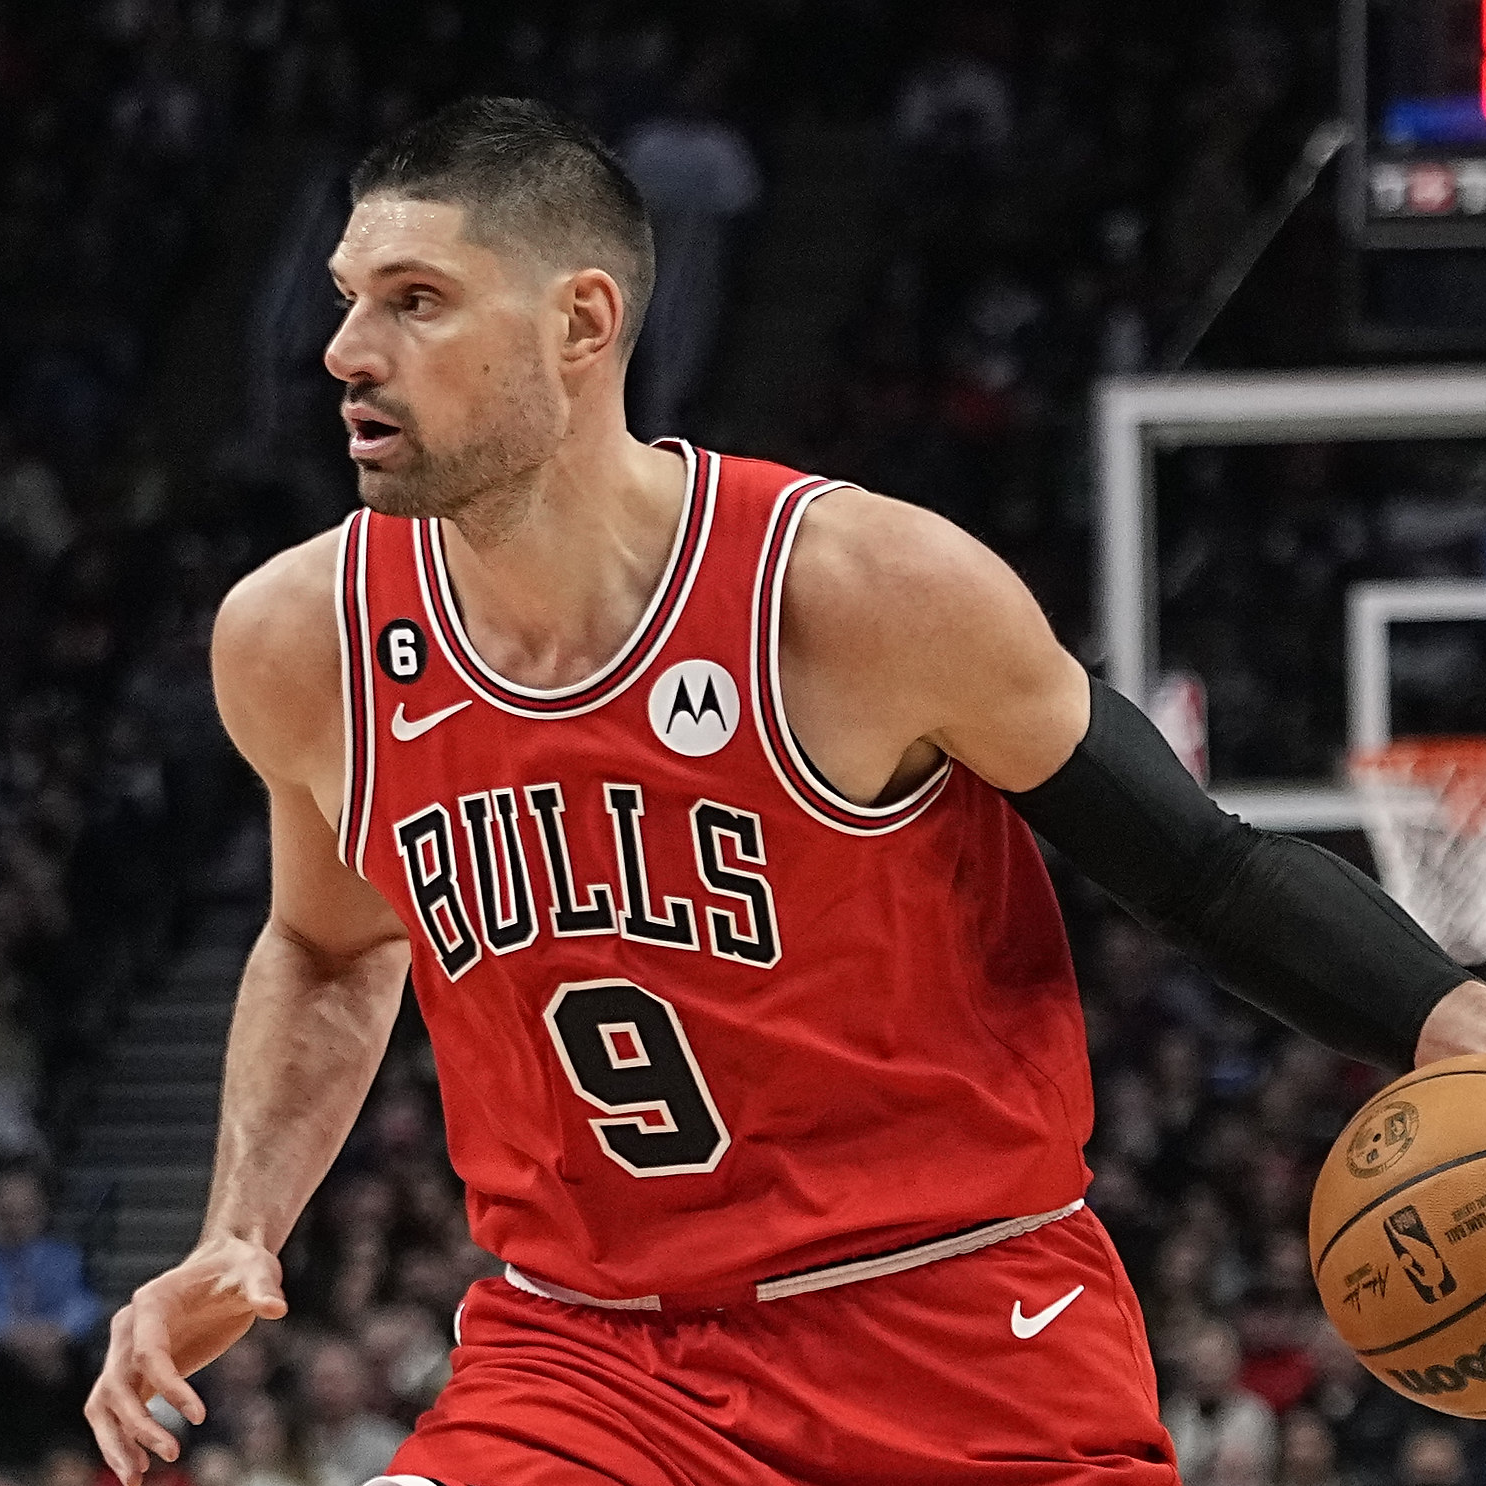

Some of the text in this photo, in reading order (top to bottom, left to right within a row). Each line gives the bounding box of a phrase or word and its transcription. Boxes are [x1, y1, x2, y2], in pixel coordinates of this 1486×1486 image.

[387, 627, 419, 677] 6
[393, 782, 782, 983] BULLS
[542, 977, 732, 1178] 9
[1444, 1224, 1468, 1246] BALL
